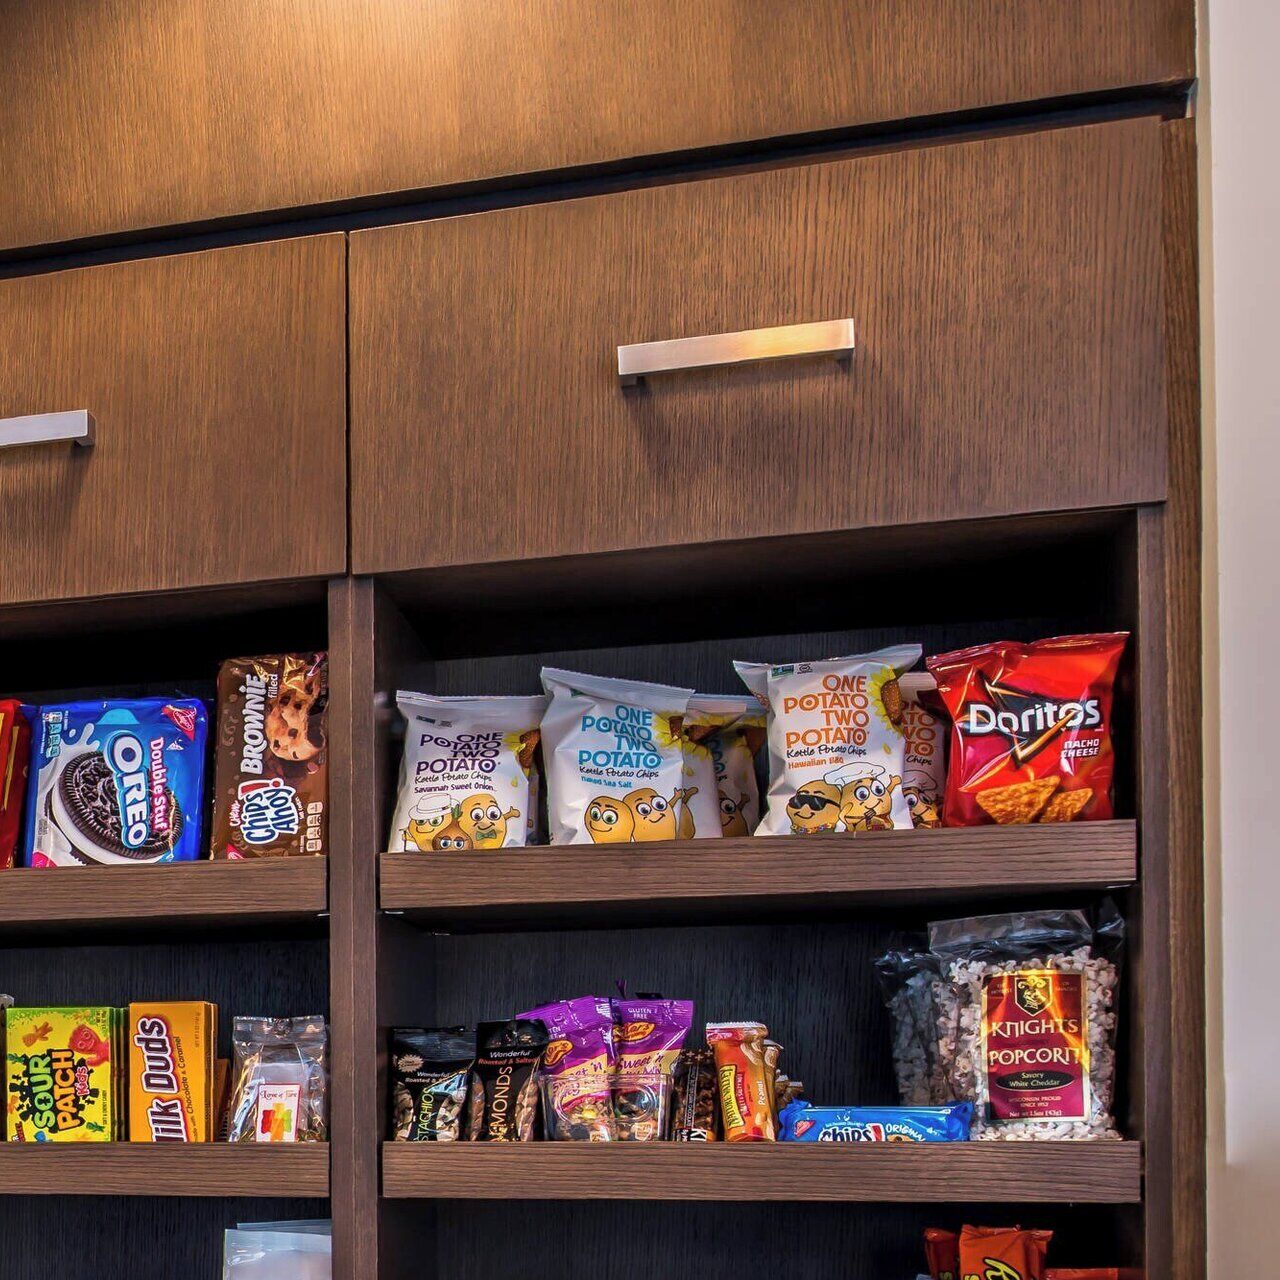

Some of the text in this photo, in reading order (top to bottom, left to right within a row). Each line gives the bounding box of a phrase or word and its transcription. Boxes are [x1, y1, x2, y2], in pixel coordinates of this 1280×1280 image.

[268, 674, 278, 699] filled
[822, 675, 867, 693] ONE
[784, 693, 868, 714] POTATO
[240, 674, 267, 775] BROWNIE
[615, 705, 652, 726] ONE
[821, 711, 870, 727] TWO
[970, 699, 1100, 734] Doritos
[457, 732, 504, 743] ONE
[581, 715, 652, 742] POTATO
[420, 734, 502, 749] POTATO
[613, 734, 656, 753] TWO
[786, 729, 868, 748] POTATO
[1064, 738, 1100, 749] NACHO
[452, 750, 500, 758] TWO
[578, 750, 662, 770] POTATO
[786, 744, 867, 758] Kettle Potato Chips
[1061, 747, 1100, 758] CHEESE
[416, 758, 496, 775] POTATO
[579, 766, 659, 779] Kettle Potato Chips
[788, 757, 828, 770] Hawaiian
[150, 737, 169, 831] Double Stuf
[415, 770, 492, 784] Kettle Potato Chips
[113, 735, 148, 847] OREO
[414, 783, 473, 793] Savannah Sweet
[242, 792, 276, 842] Chips
[992, 1019, 1079, 1037] KNIGHTS
[138, 1018, 177, 1093] Duds
[490, 1050, 531, 1058] Wonderful
[990, 1048, 1080, 1065] POPCORN
[1009, 1078, 1060, 1088] White Cheddar
[1021, 1071, 1044, 1080] Savory
[30, 1056, 55, 1128] SOUR
[52, 1050, 75, 1130] PATCH
